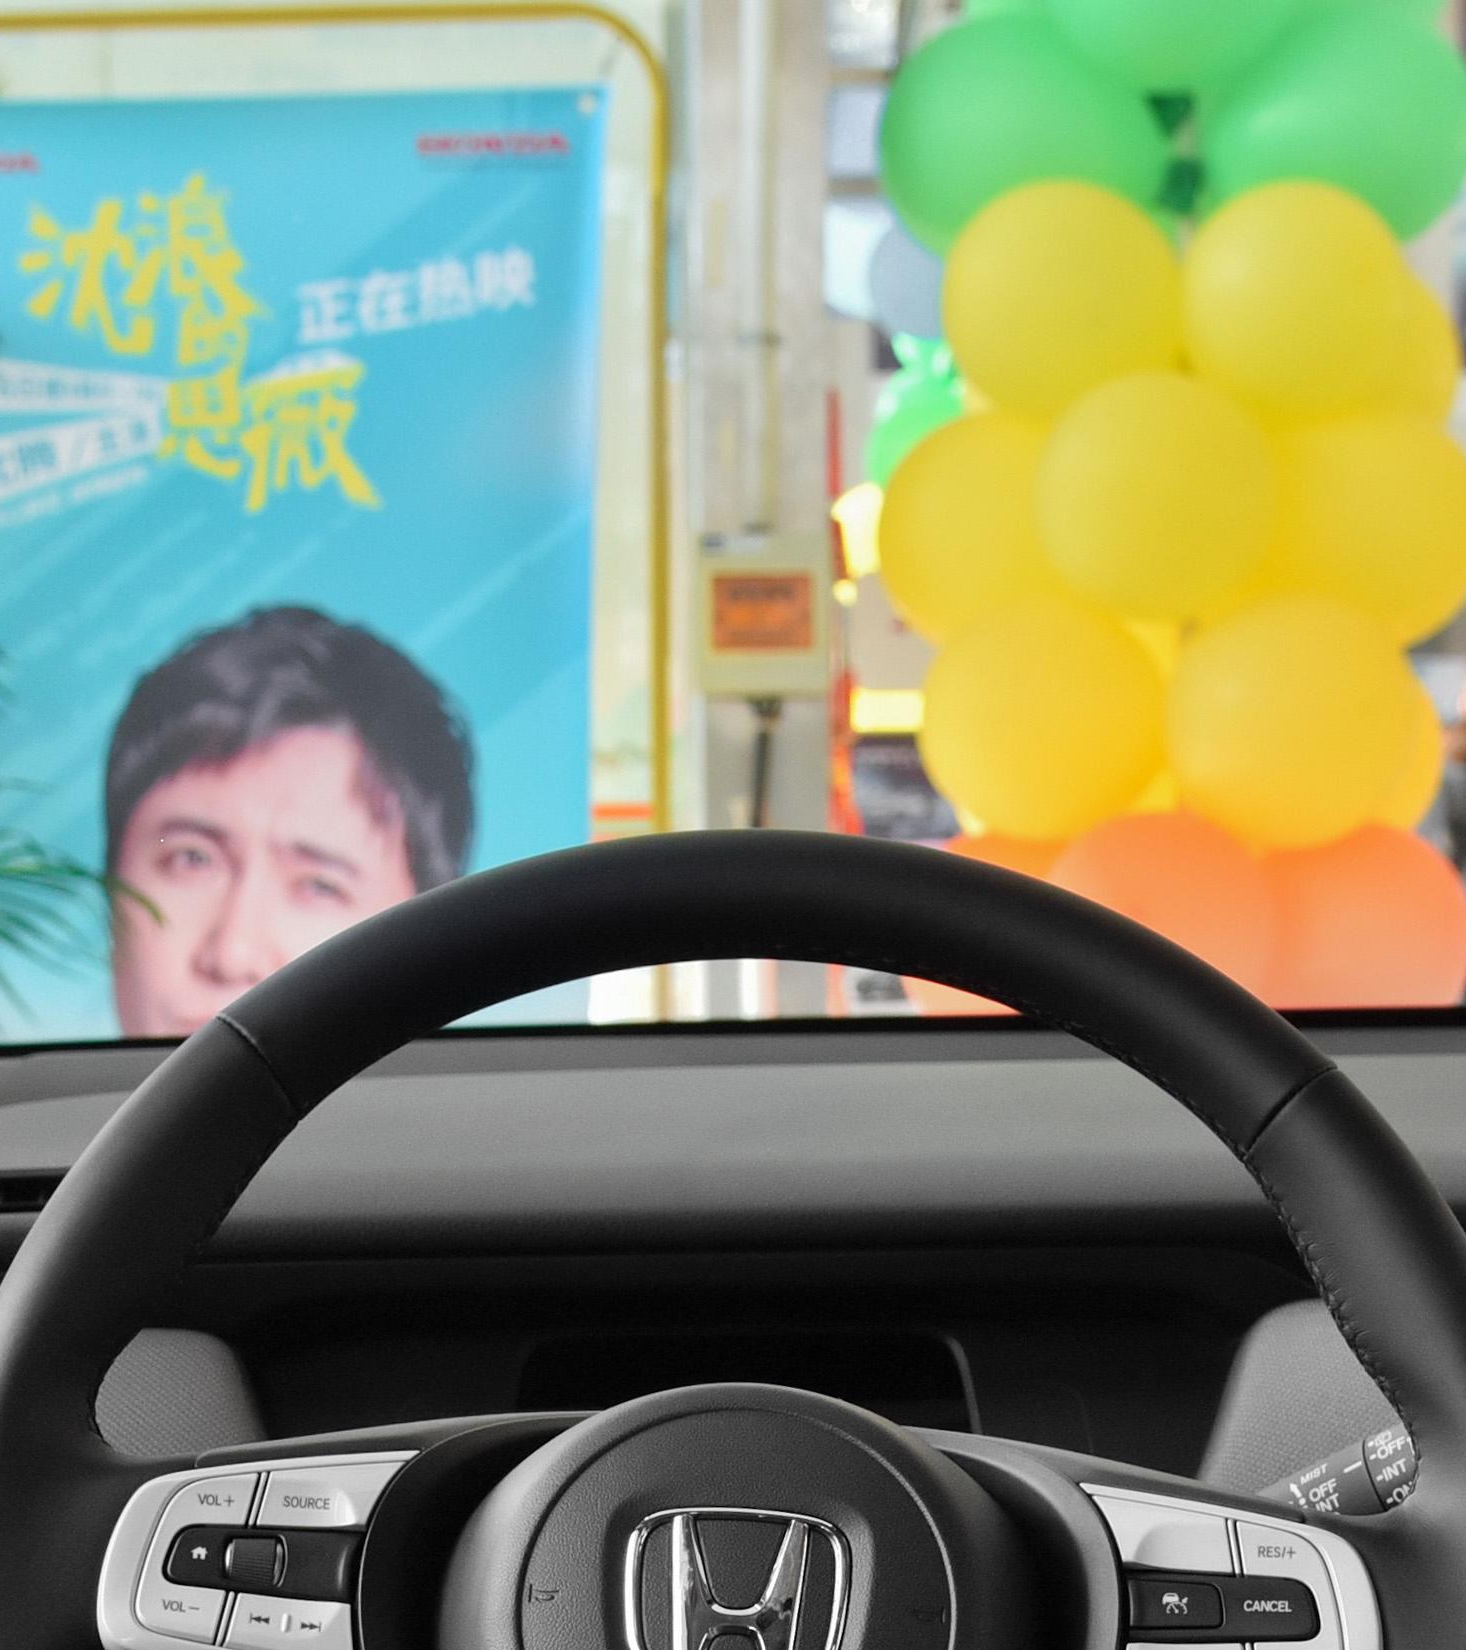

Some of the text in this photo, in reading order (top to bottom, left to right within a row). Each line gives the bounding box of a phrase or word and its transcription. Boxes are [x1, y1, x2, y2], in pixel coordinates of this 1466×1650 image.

[297, 244, 536, 344] 正在热映
[1377, 1436, 1405, 1459] OFF
[1300, 1463, 1328, 1485] MIST
[1382, 1458, 1406, 1482] INT
[197, 1494, 235, 1507] VOL+
[1309, 1478, 1337, 1502] OFF
[283, 1496, 330, 1510] SOURCE
[1257, 1546, 1296, 1559] RES/+
[1243, 1600, 1292, 1613] CANCEL
